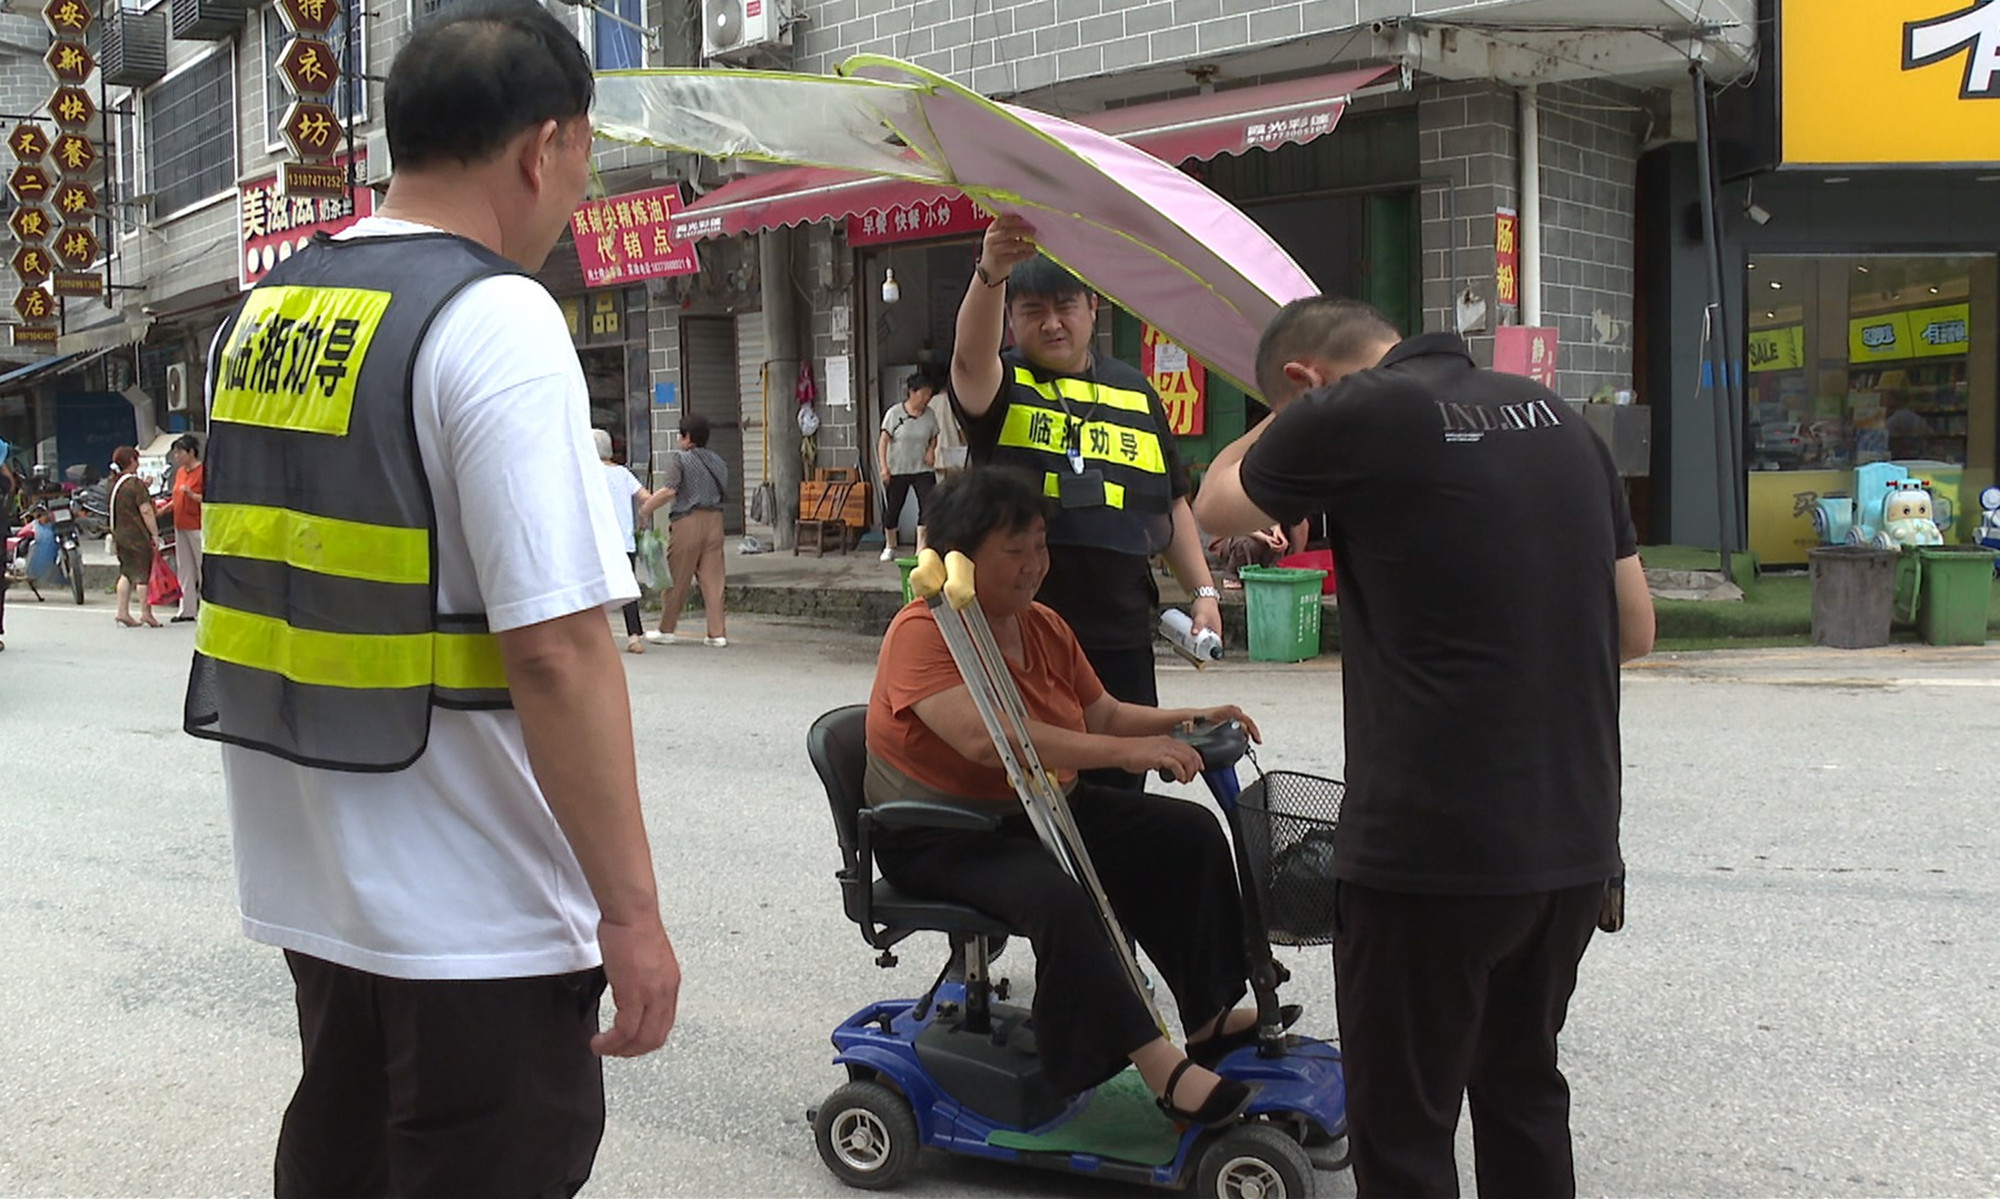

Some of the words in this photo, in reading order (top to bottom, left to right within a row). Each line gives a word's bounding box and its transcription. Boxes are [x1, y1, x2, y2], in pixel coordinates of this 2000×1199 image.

[18, 133, 46, 316] 不二便民店
[598, 226, 672, 264] 代销点
[895, 207, 920, 232] 快餐
[924, 203, 951, 229] 小炒
[1496, 218, 1515, 300] 肠粉
